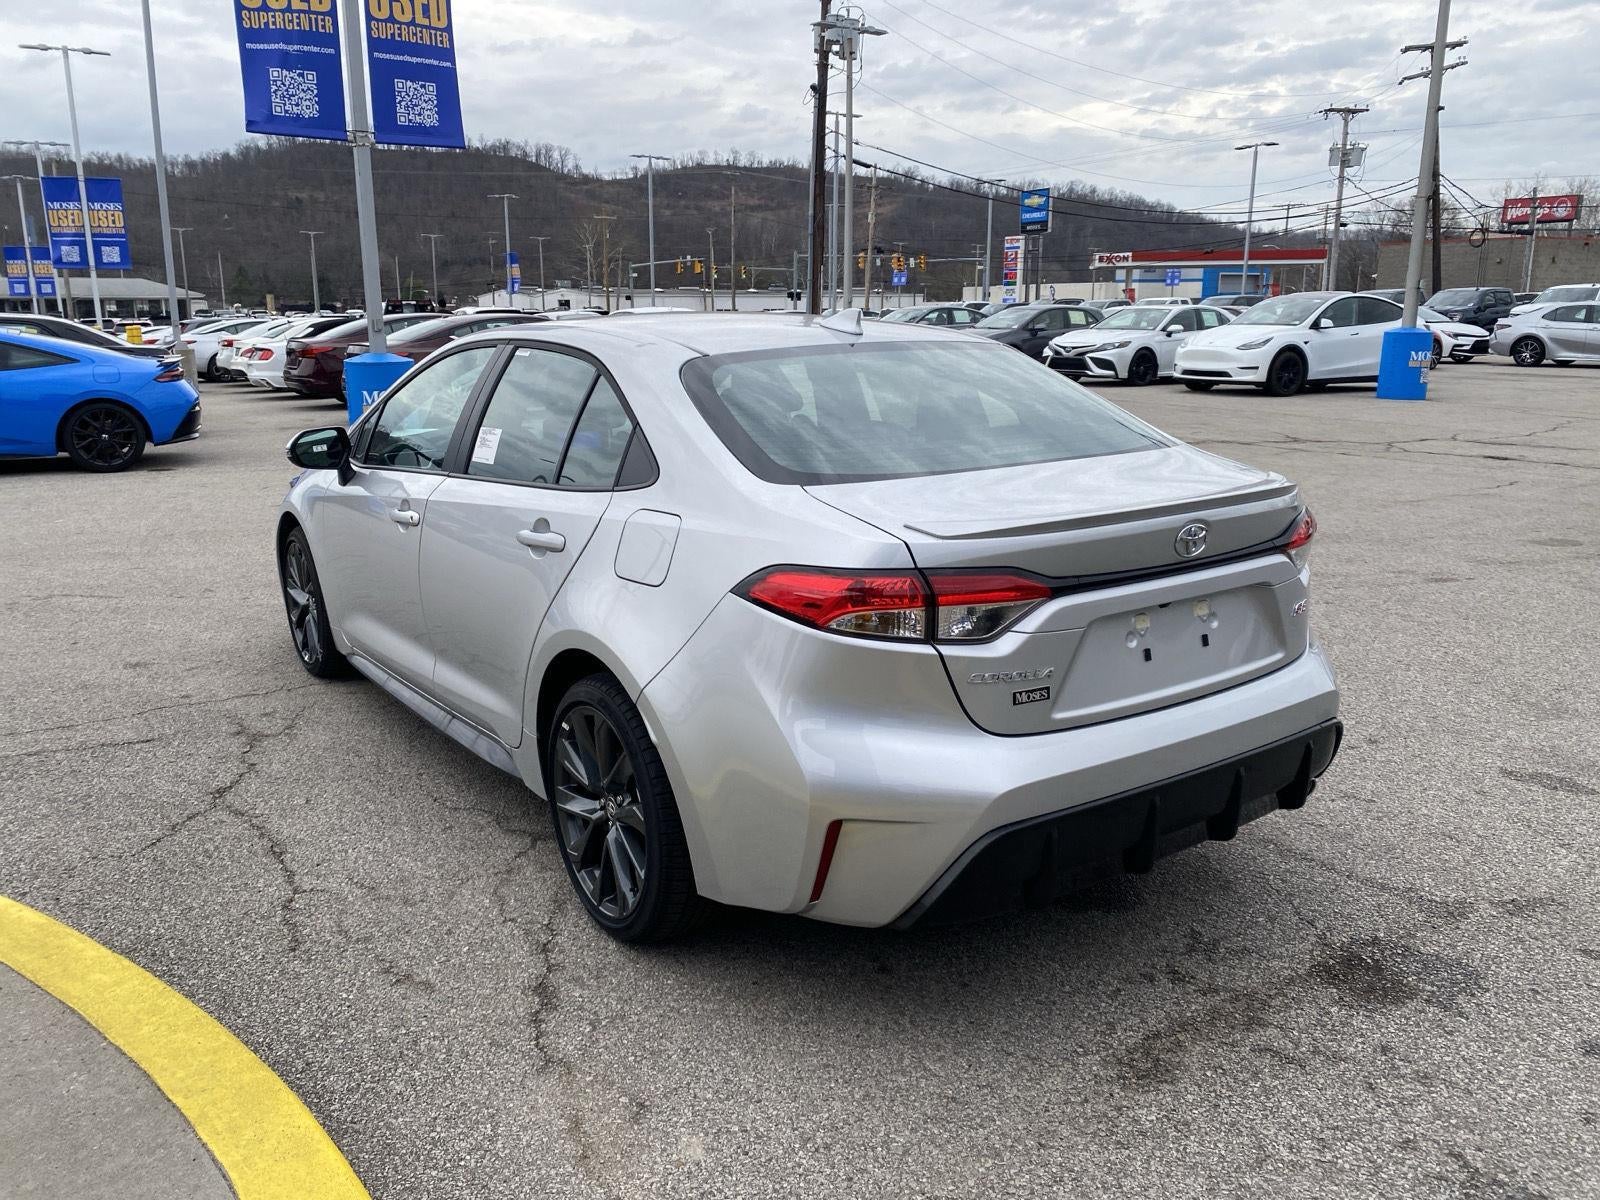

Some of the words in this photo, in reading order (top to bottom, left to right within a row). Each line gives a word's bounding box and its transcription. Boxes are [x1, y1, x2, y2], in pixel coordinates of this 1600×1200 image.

[241, 10, 334, 34] SUPERCENTER
[370, 20, 450, 48] SUPERCENTER
[245, 41, 336, 54] mosesusedsupercenter.com
[373, 51, 453, 68] mosesusedsupercenter.com
[47, 201, 82, 210] MOSES
[88, 202, 123, 211] MOSES
[1507, 200, 1551, 220] Weny's
[48, 209, 84, 227] USED
[89, 210, 125, 228] USED
[1022, 211, 1047, 220] CHEVROLET
[1098, 254, 1130, 265] EXXON
[361, 390, 386, 406] M
[966, 666, 1055, 683] COROLLA
[1015, 689, 1049, 704] MOSES
